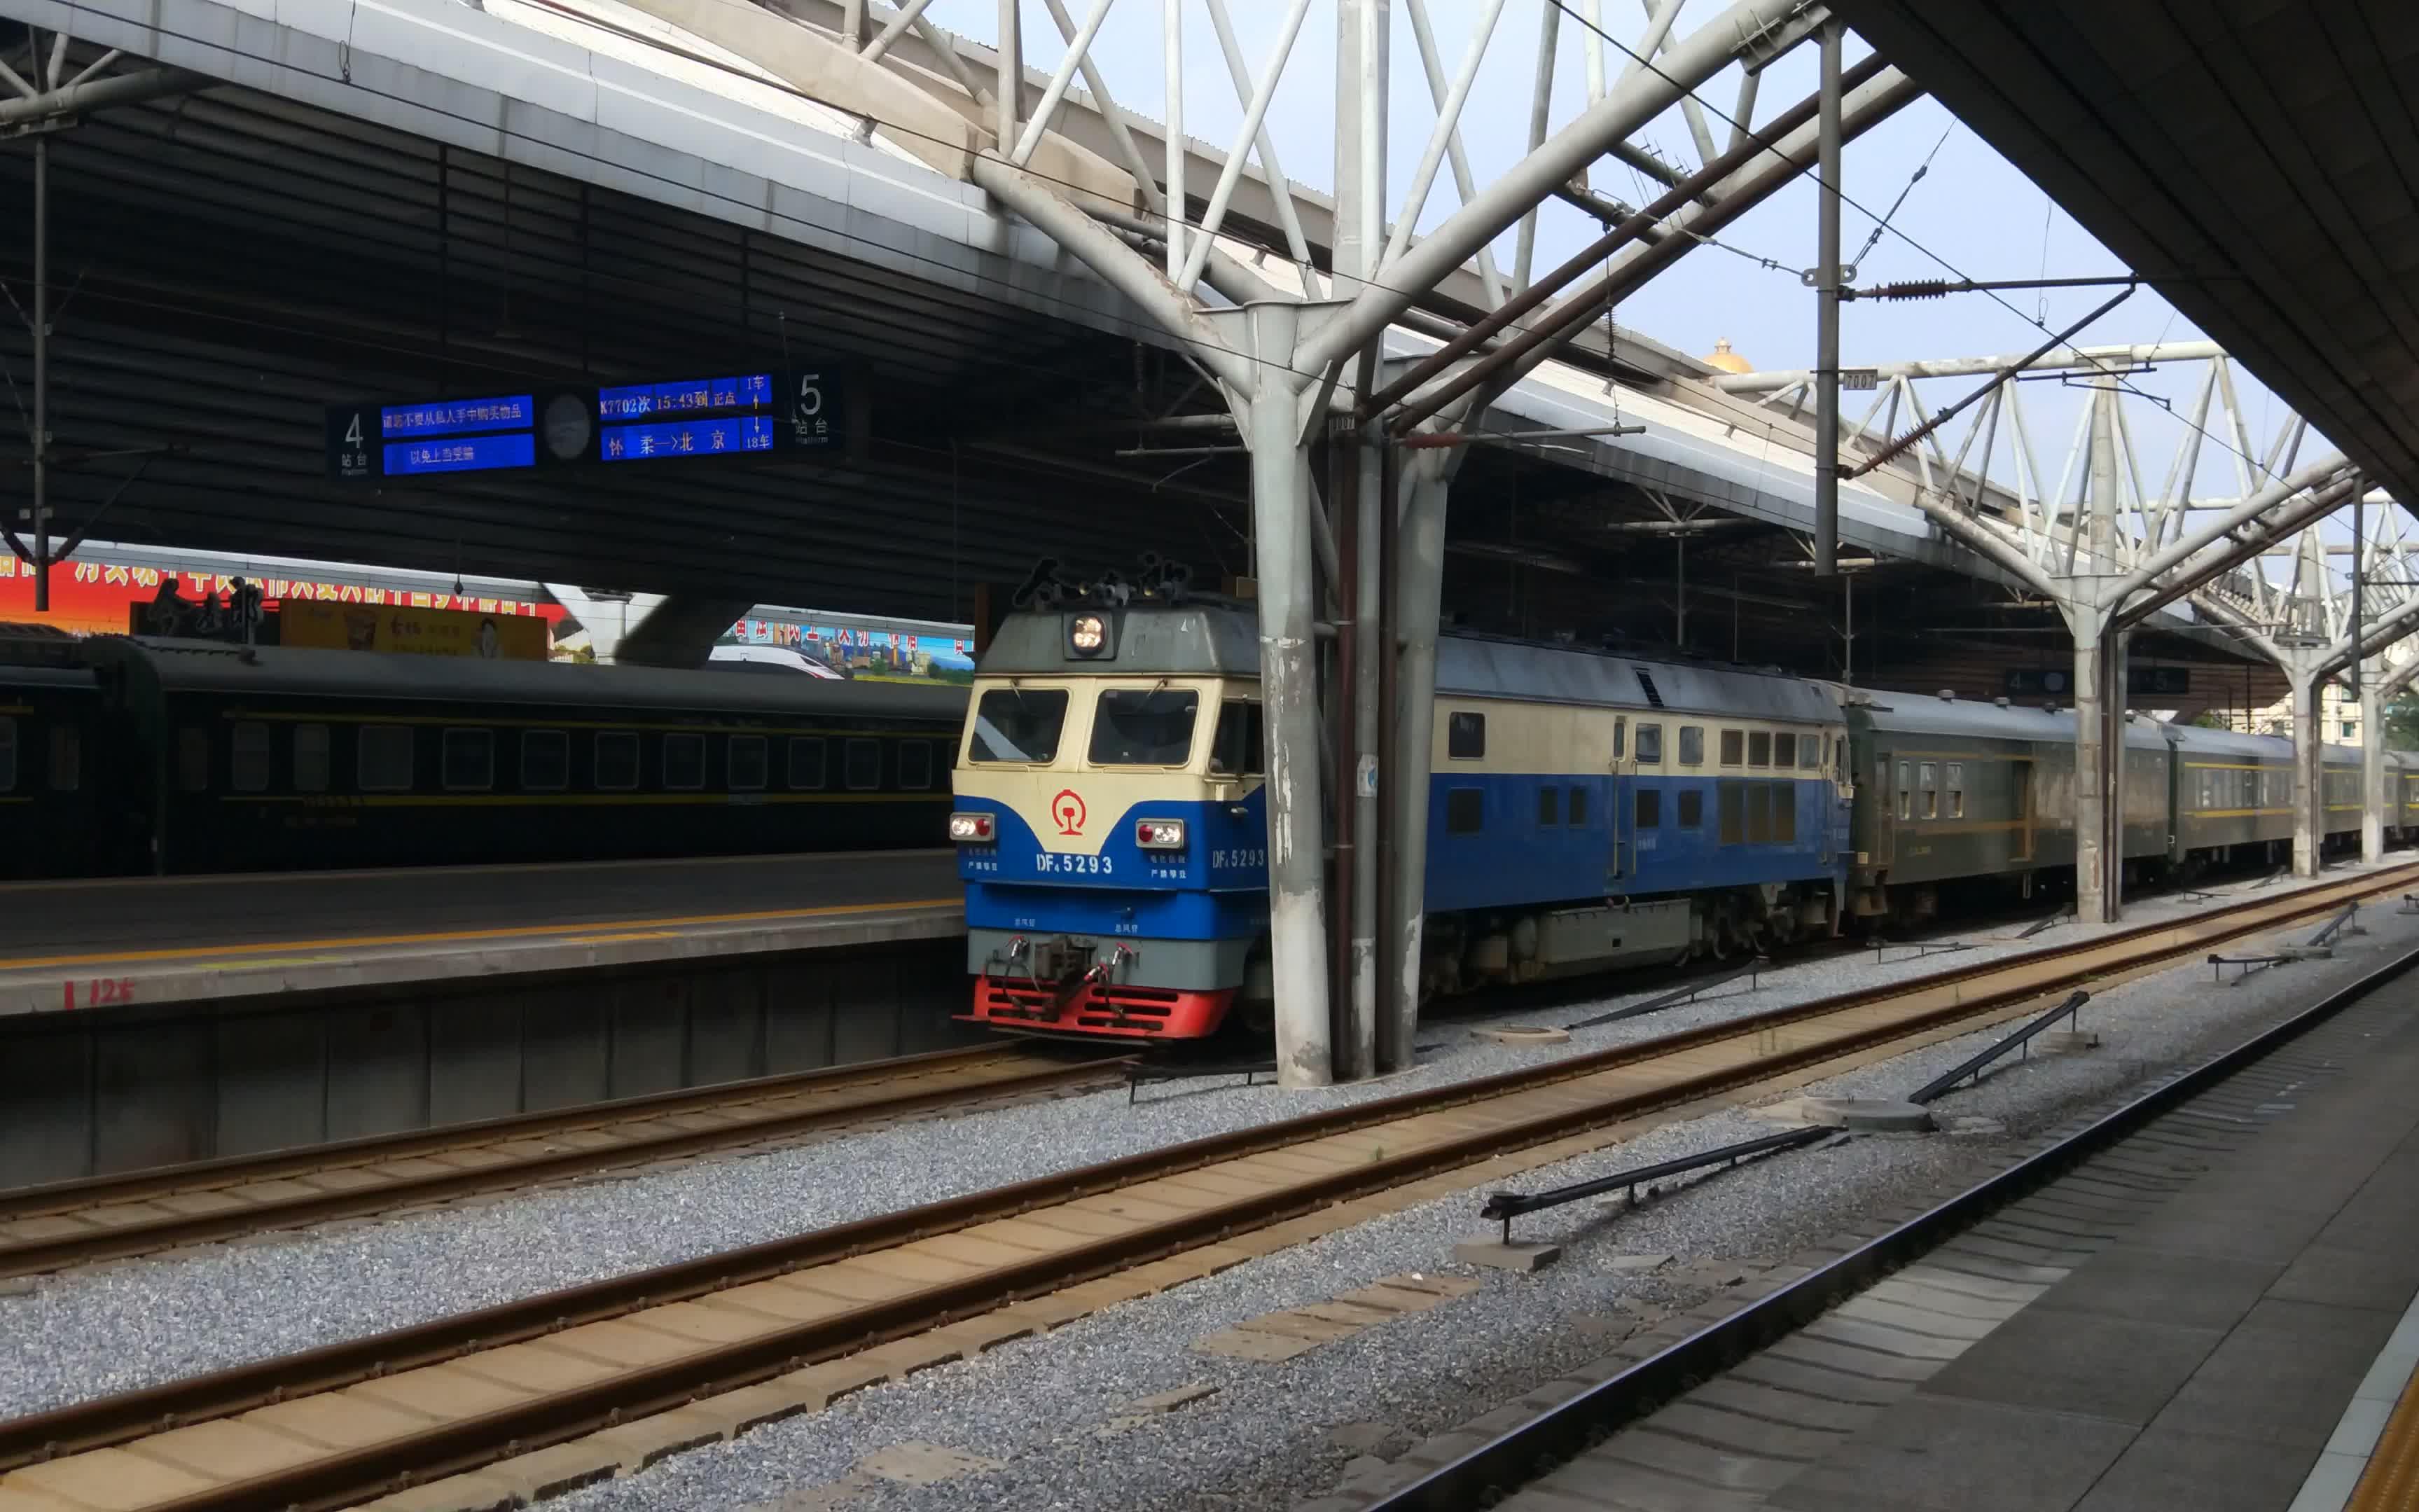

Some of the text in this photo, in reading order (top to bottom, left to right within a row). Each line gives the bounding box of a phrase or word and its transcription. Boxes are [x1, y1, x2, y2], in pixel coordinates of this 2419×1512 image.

[1847, 375, 1875, 389] 7007
[800, 373, 822, 415] 5
[345, 412, 364, 449] 4
[795, 417, 829, 435] 站台
[341, 450, 368, 468] 站台
